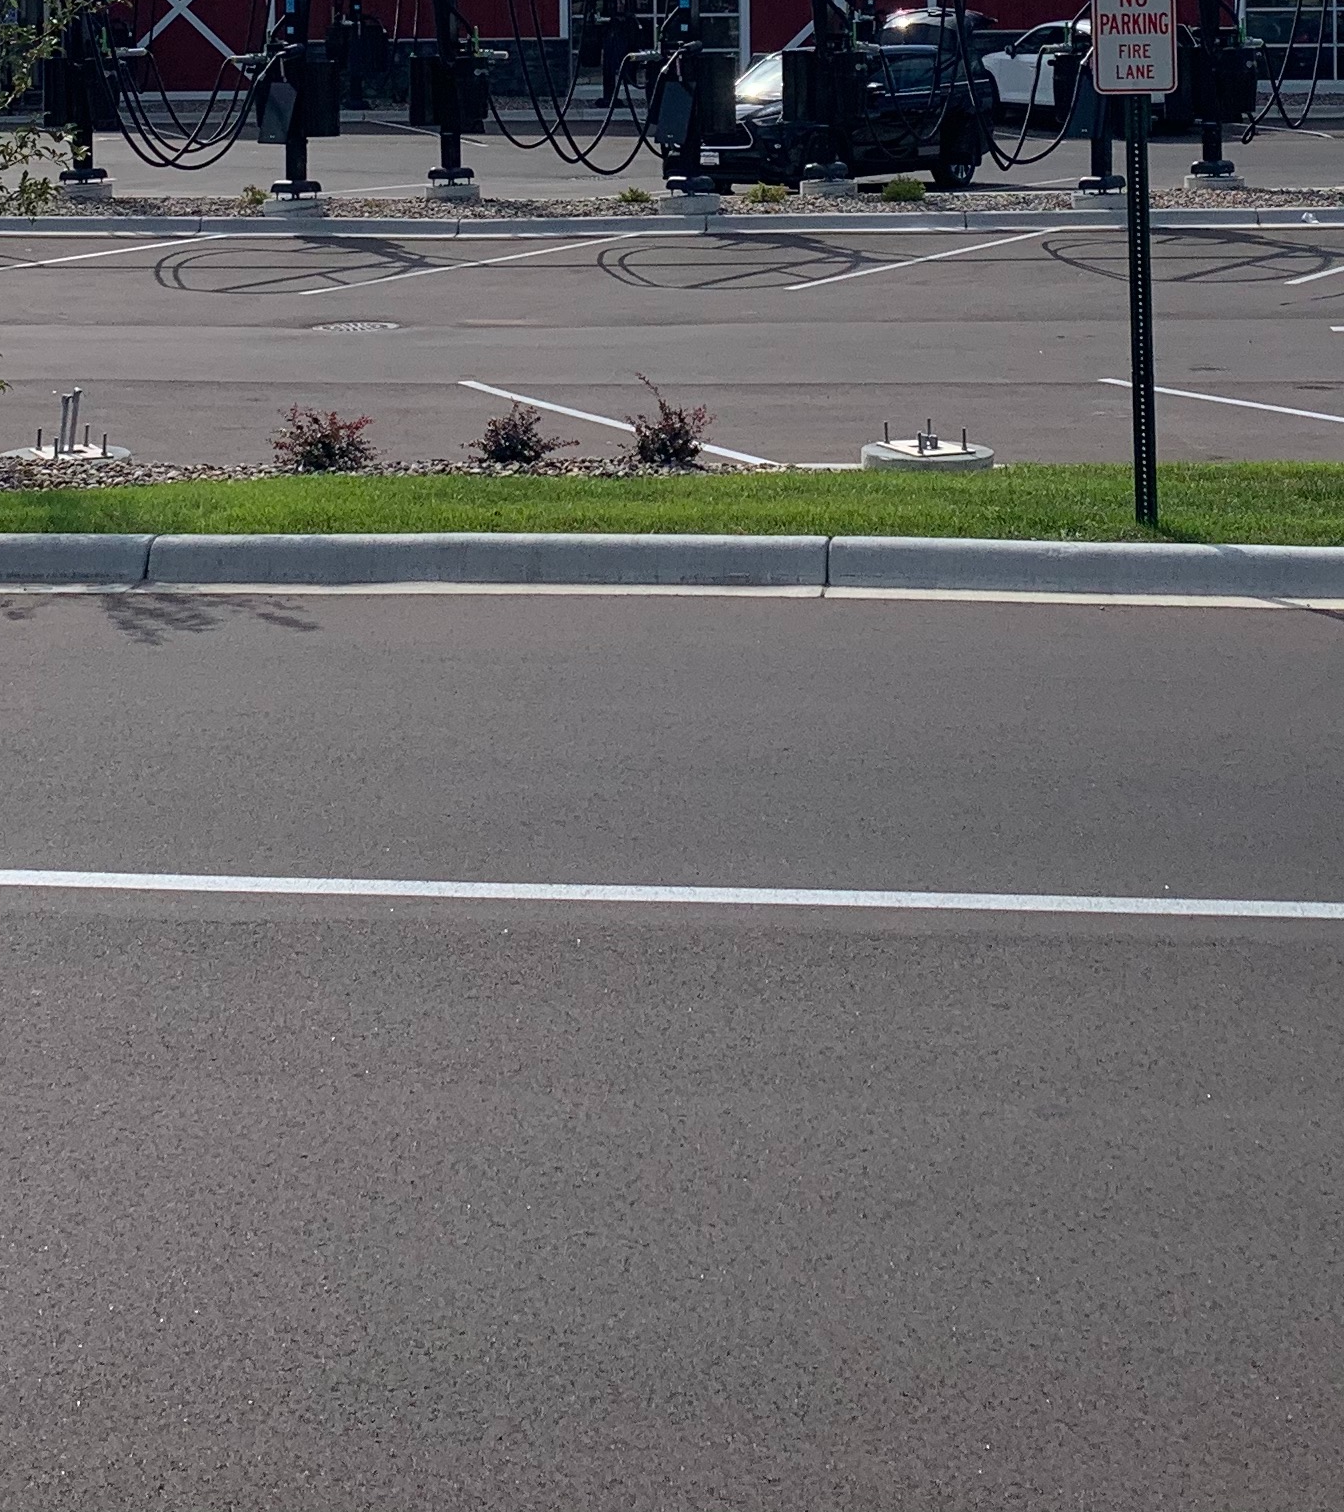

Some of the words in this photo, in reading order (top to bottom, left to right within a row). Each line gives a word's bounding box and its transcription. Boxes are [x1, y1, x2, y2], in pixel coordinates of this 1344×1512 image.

[1100, 12, 1169, 35] PARKING
[1119, 44, 1151, 59] FIRE
[1116, 64, 1155, 80] LANE
